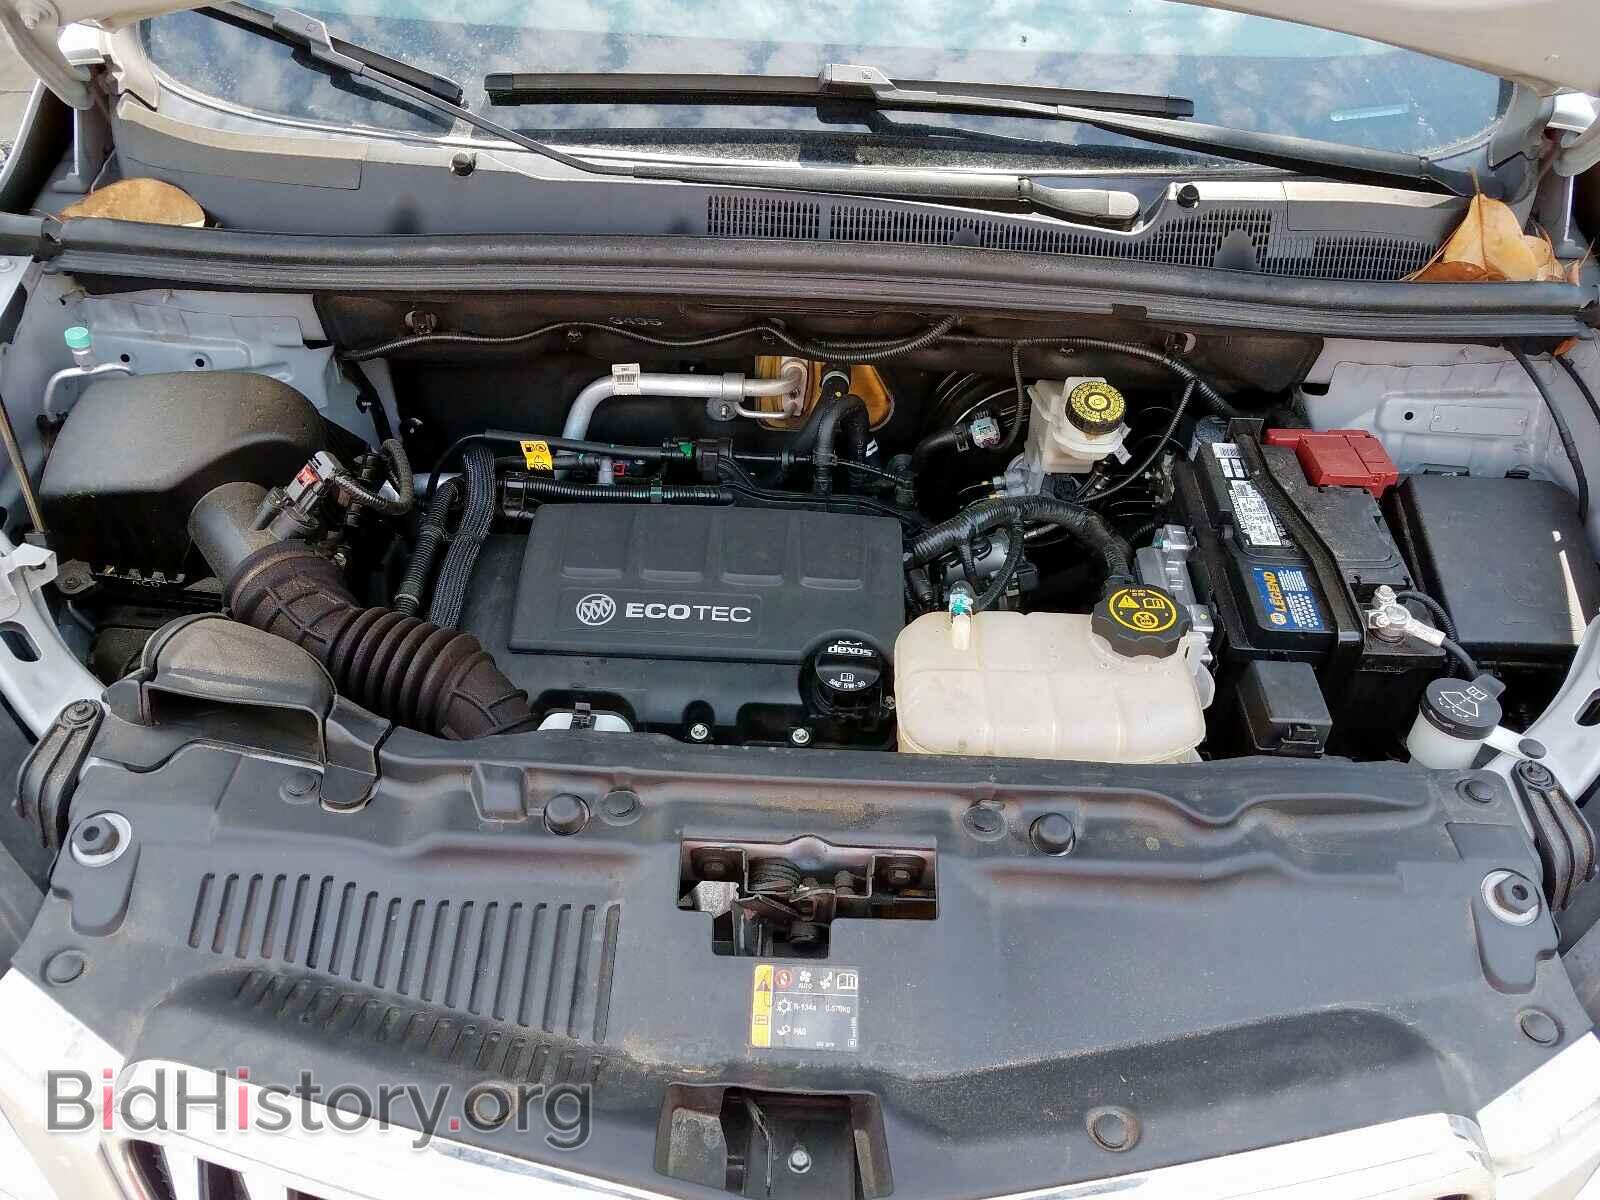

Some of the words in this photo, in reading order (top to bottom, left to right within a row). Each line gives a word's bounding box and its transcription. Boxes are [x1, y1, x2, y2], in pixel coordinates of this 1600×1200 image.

[1263, 571, 1287, 612] LEGEND
[625, 602, 752, 623] ECOTEC
[827, 645, 874, 657] dexos
